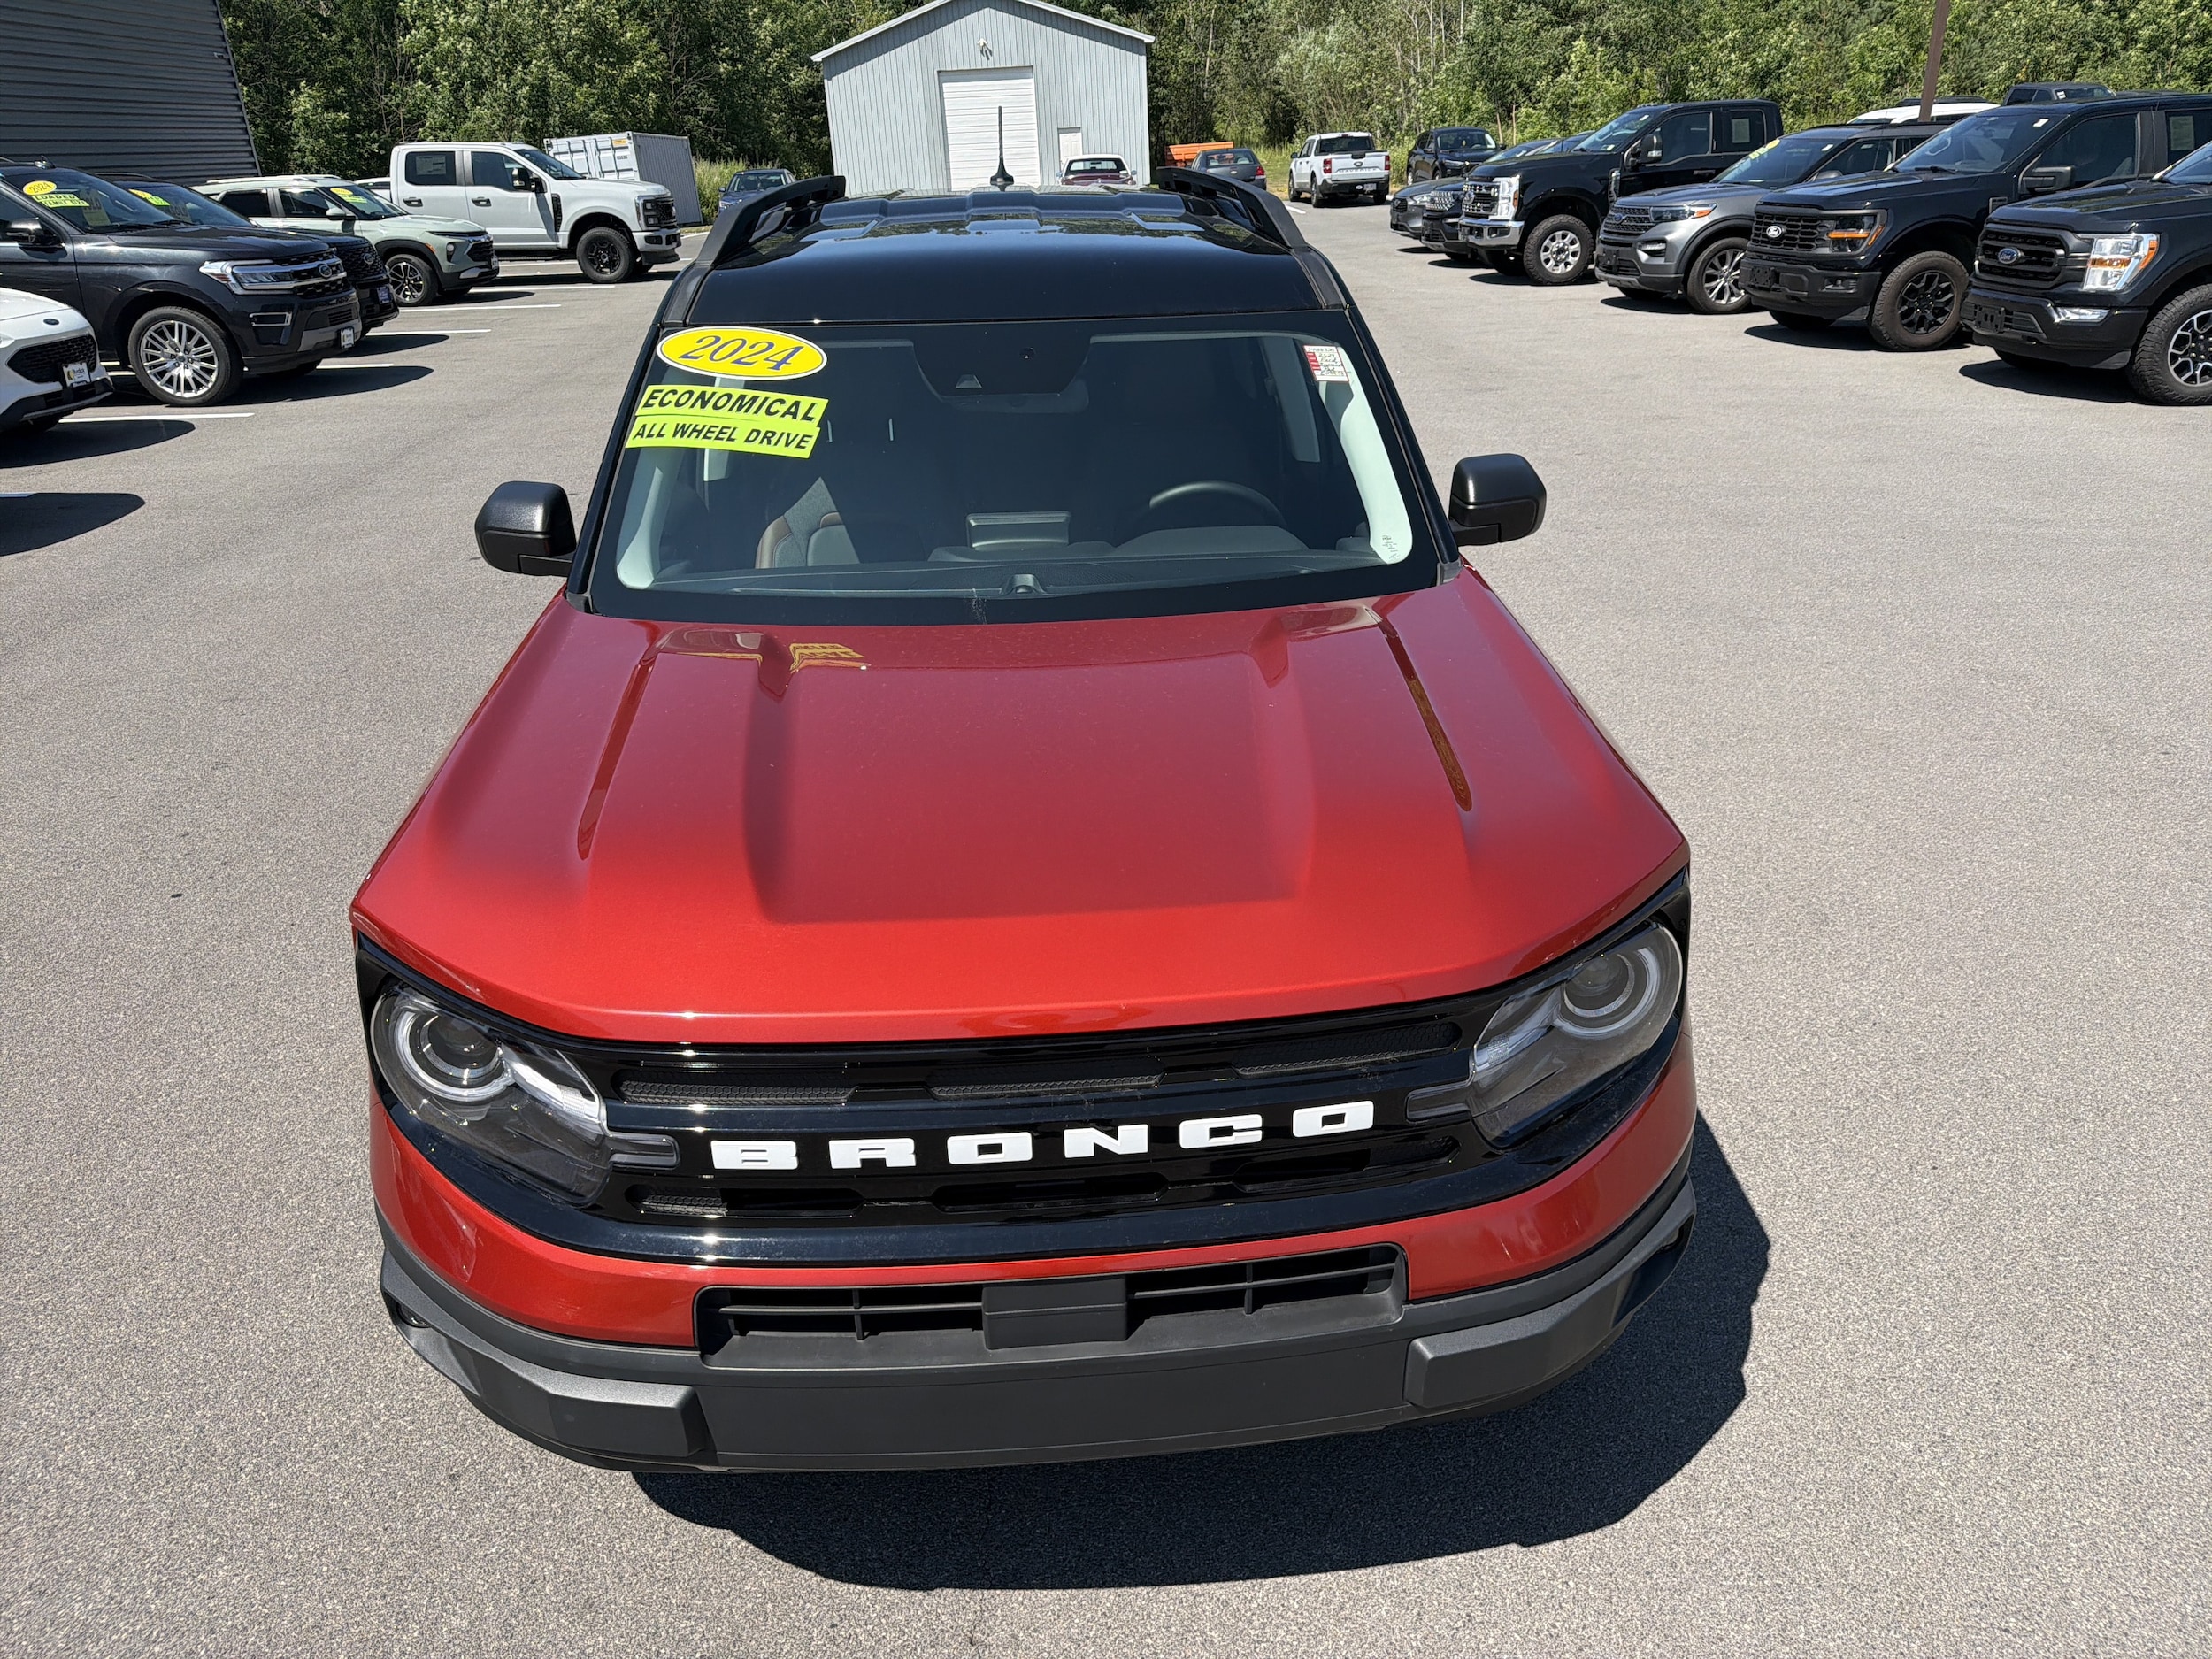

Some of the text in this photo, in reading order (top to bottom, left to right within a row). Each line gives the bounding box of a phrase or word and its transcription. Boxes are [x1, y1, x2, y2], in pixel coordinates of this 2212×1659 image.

[29, 182, 51, 194] 2024
[678, 335, 803, 371] 2024
[641, 389, 818, 421] ECONOMICAL
[634, 423, 812, 449] ALL WHEEL DRIVE
[710, 1101, 1374, 1170] BRONCO
